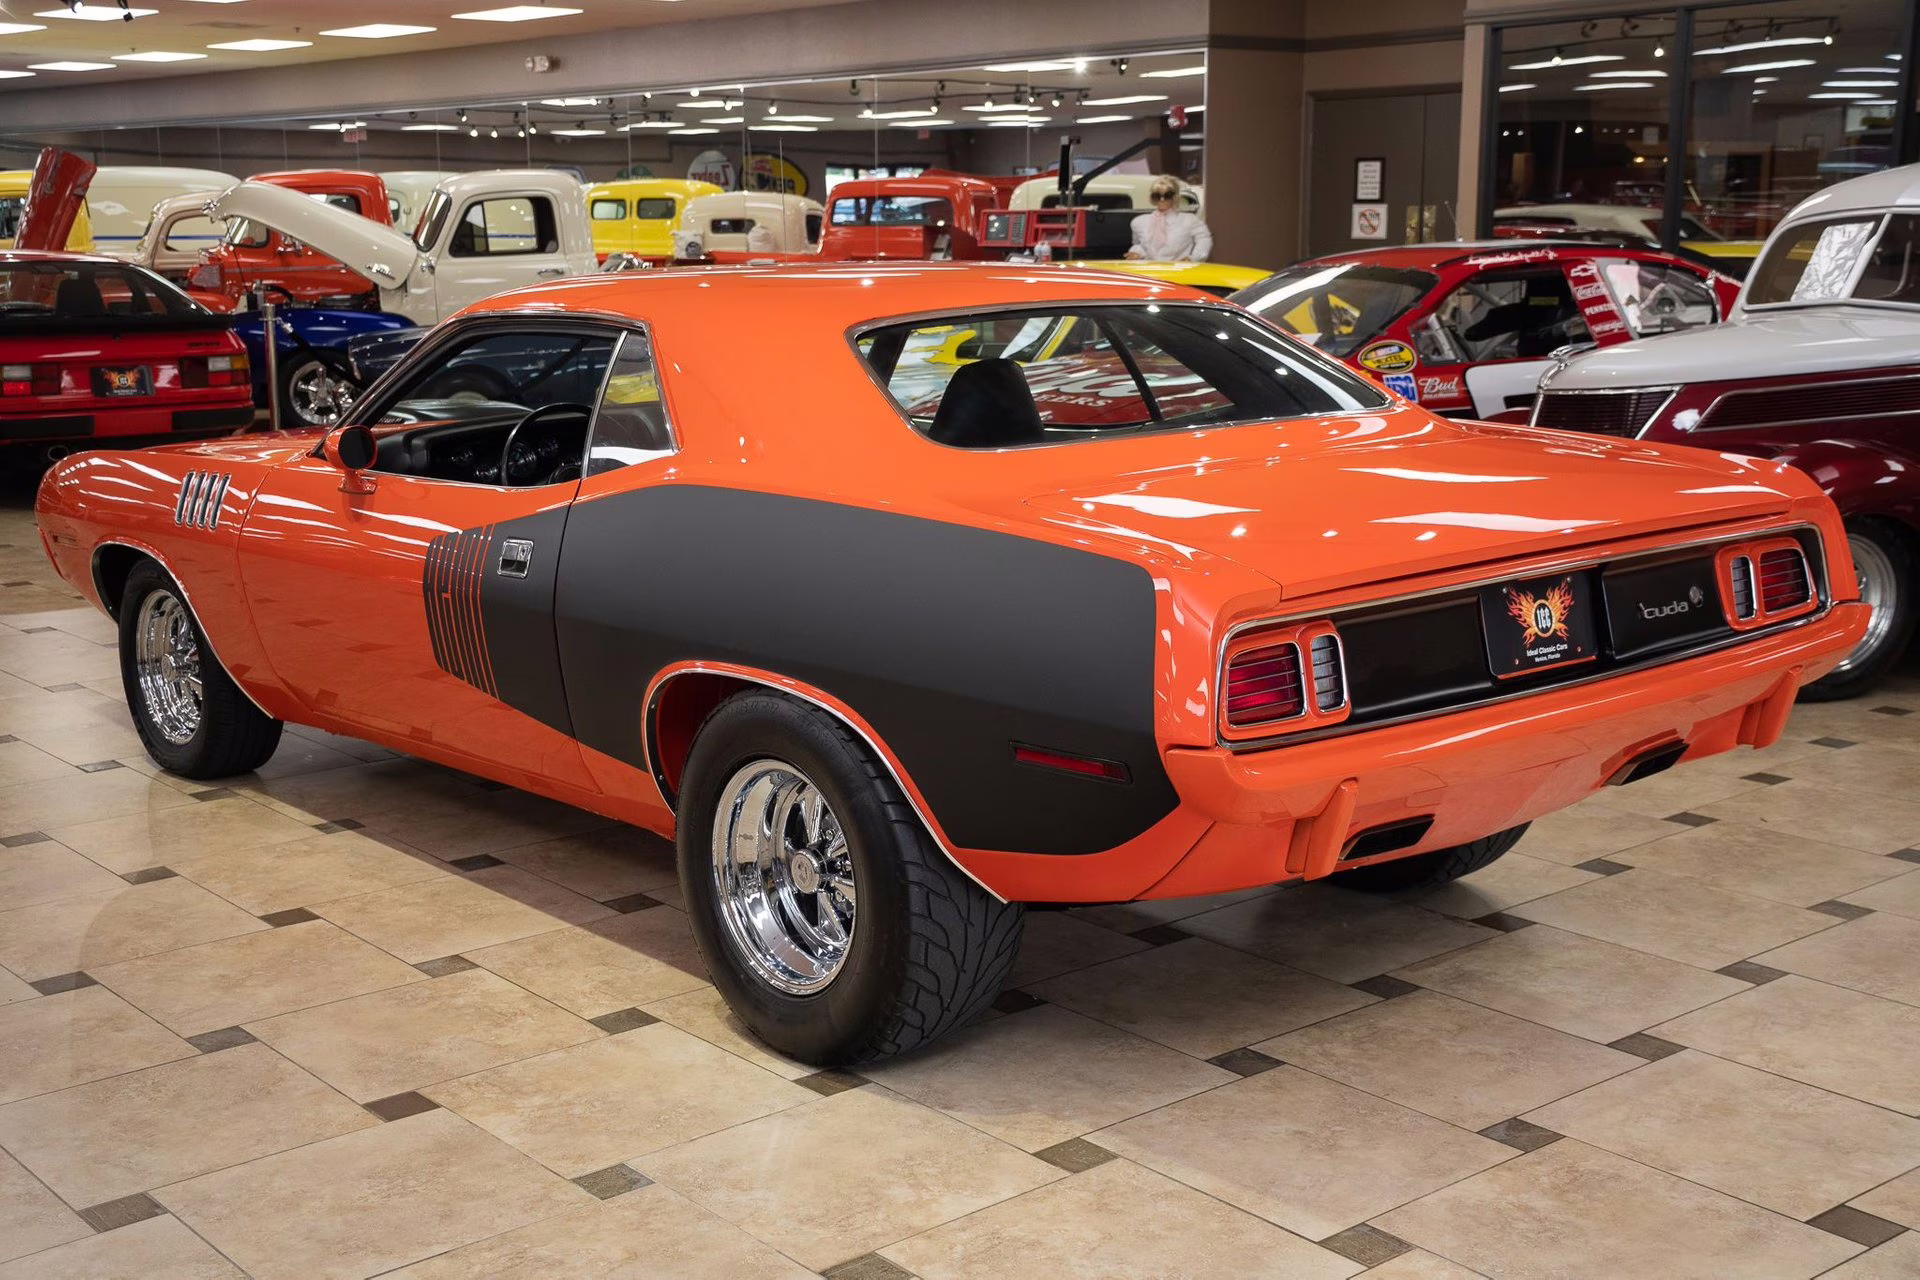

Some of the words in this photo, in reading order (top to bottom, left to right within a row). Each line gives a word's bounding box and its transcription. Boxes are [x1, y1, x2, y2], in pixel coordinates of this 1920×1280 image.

[1418, 376, 1460, 394] Bud
[1033, 394, 1113, 407] EERS
[1526, 648, 1539, 657] Ideal
[1539, 645, 1556, 655] Classic
[1556, 643, 1568, 651] Cars
